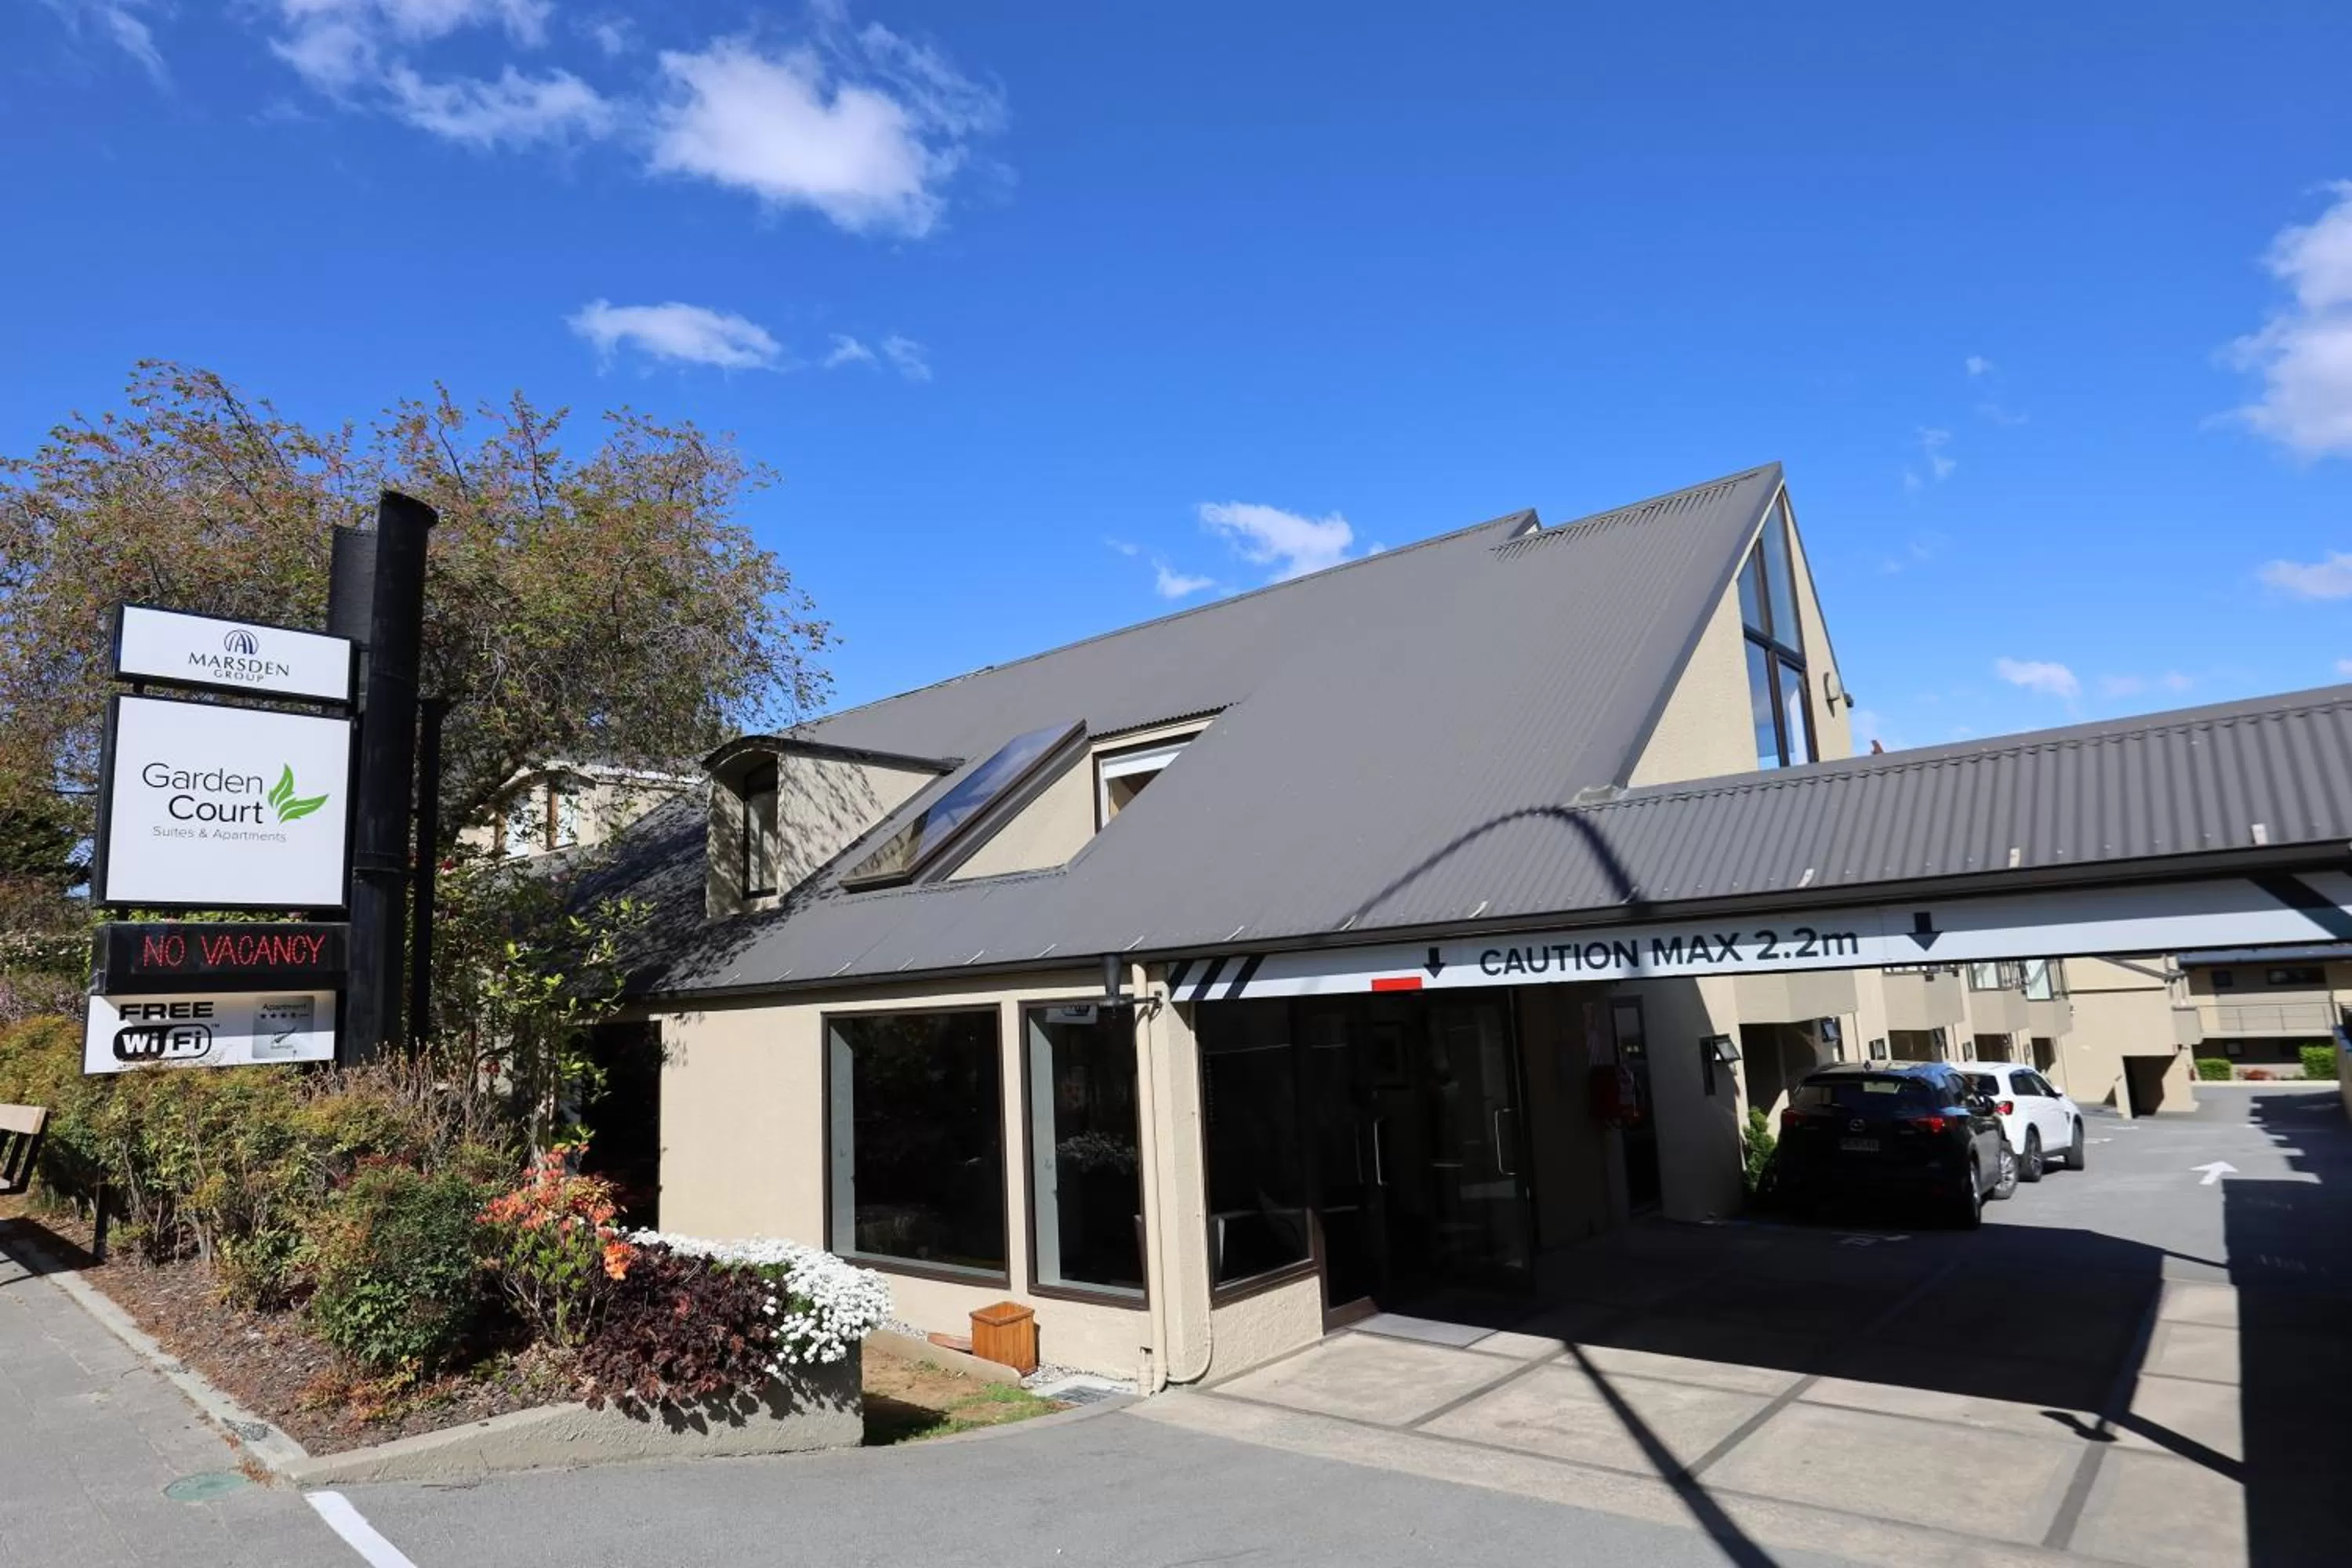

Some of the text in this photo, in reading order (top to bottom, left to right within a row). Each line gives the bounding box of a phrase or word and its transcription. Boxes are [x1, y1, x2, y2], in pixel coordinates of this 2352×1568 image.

[188, 652, 289, 677] MARSDEN
[213, 669, 264, 682] GROUP
[142, 763, 263, 794] Garden
[169, 795, 263, 824] Court
[153, 826, 286, 843] Suites & Apartments
[143, 934, 326, 967] NO VACANCY
[1479, 927, 1859, 977] CAUTION MAX 2.2m
[119, 1001, 214, 1021] FREE
